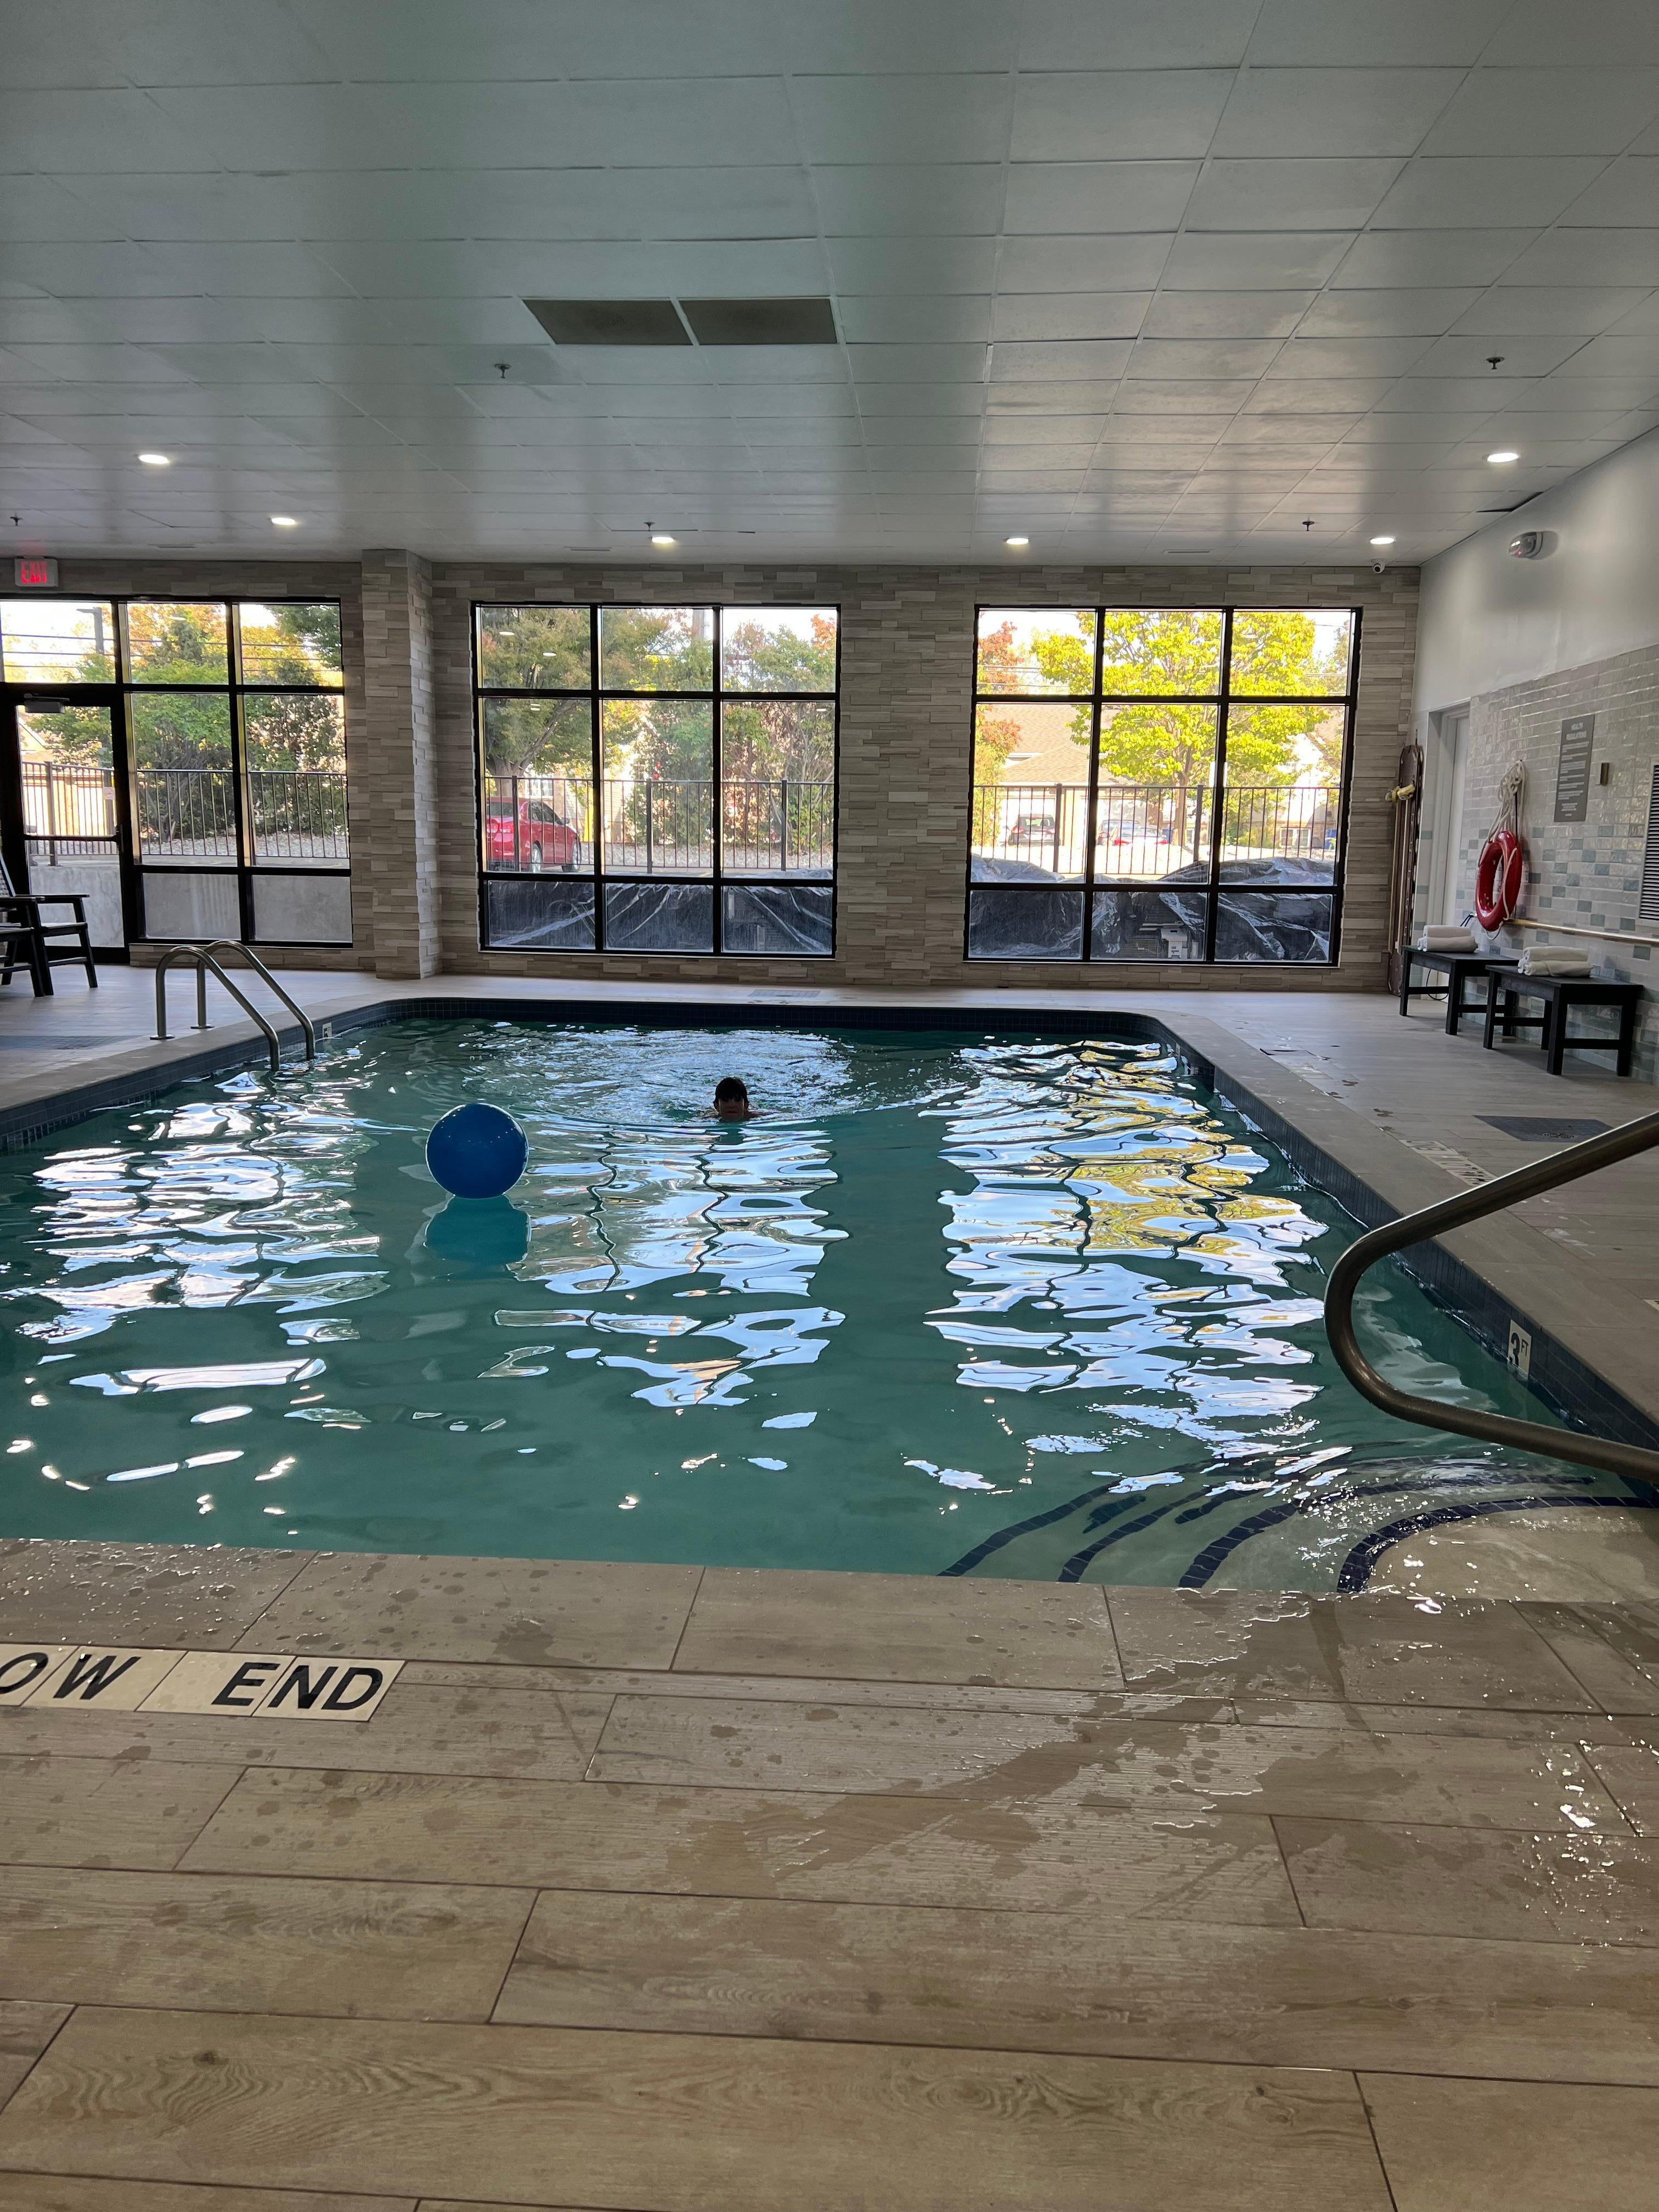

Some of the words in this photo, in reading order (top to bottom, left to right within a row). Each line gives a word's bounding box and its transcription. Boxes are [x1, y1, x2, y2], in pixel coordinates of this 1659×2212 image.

[1509, 1332, 1520, 1368] 3
[1521, 1339, 1529, 1356] FT
[211, 1662, 383, 1711] END
